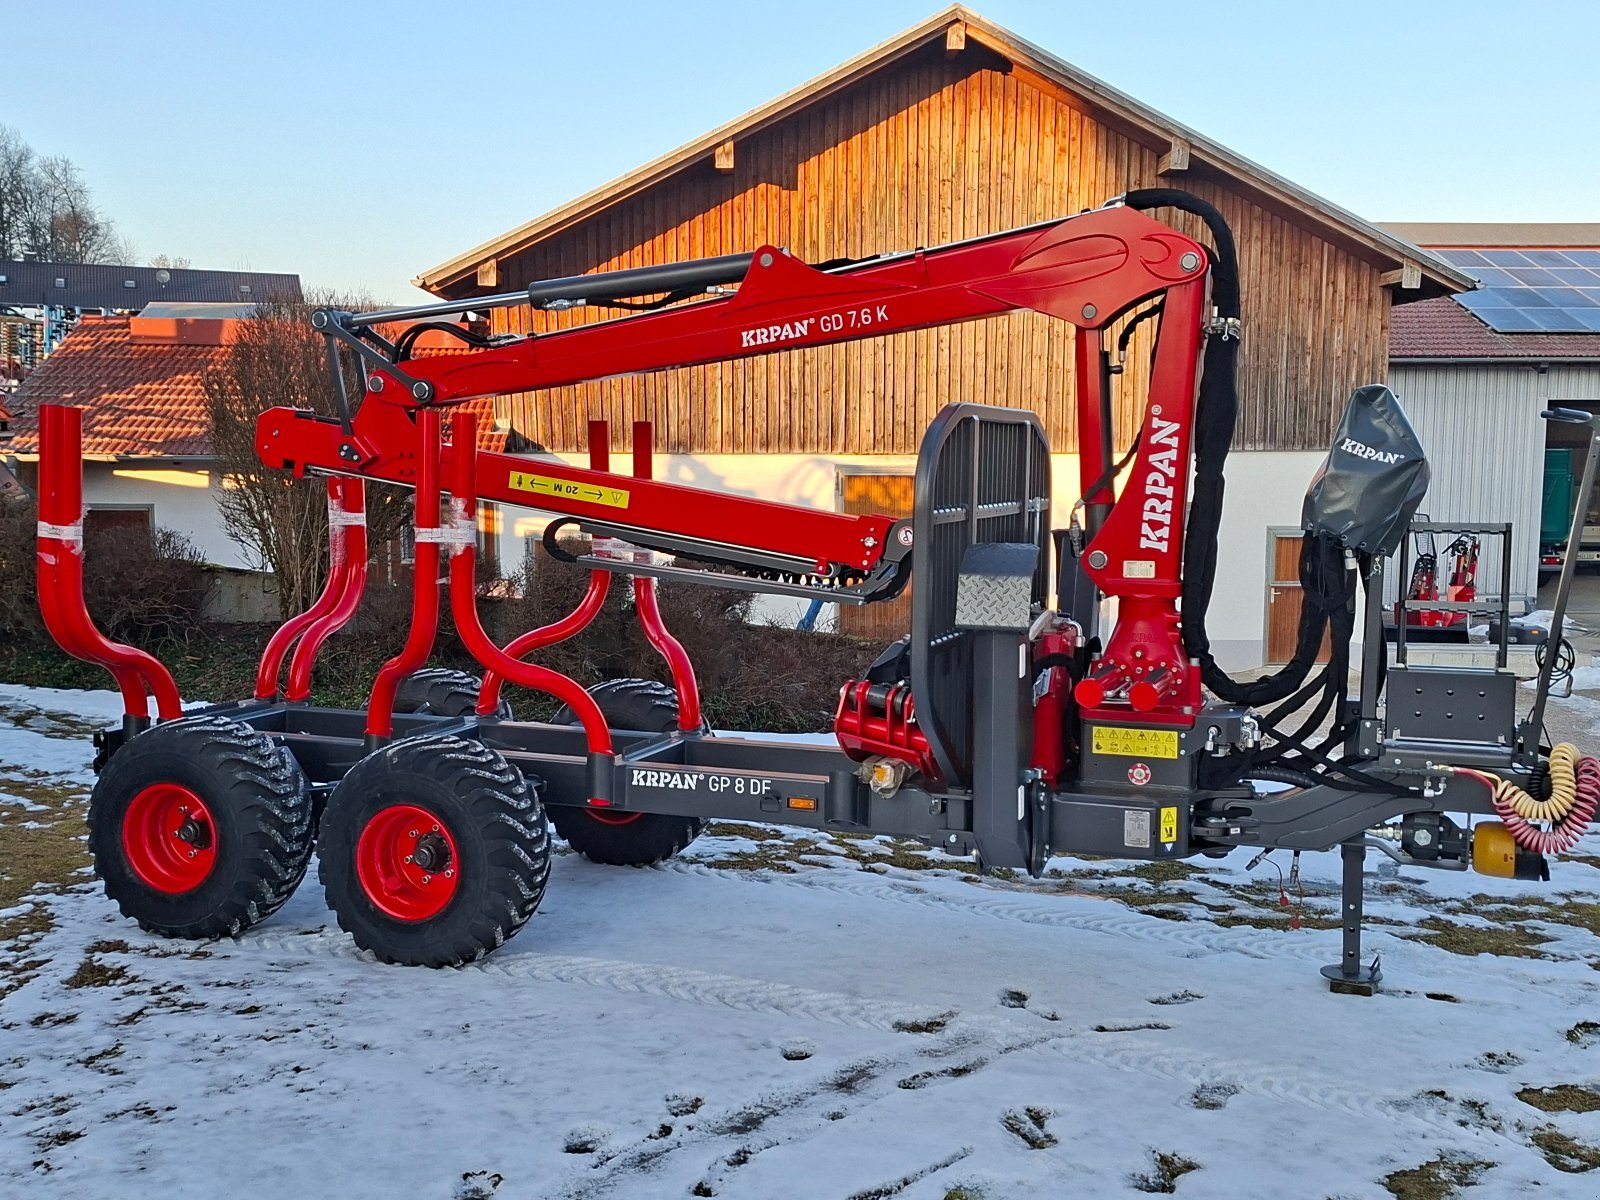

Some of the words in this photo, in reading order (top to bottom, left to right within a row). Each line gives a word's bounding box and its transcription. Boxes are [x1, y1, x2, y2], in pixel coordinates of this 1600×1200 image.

[820, 313, 844, 333] GD
[847, 308, 872, 328] 7,6
[876, 304, 889, 322] K
[553, 482, 563, 492] M
[566, 485, 579, 495] 20
[708, 775, 731, 793] GP
[734, 777, 745, 794] 8
[750, 778, 772, 795] DF
